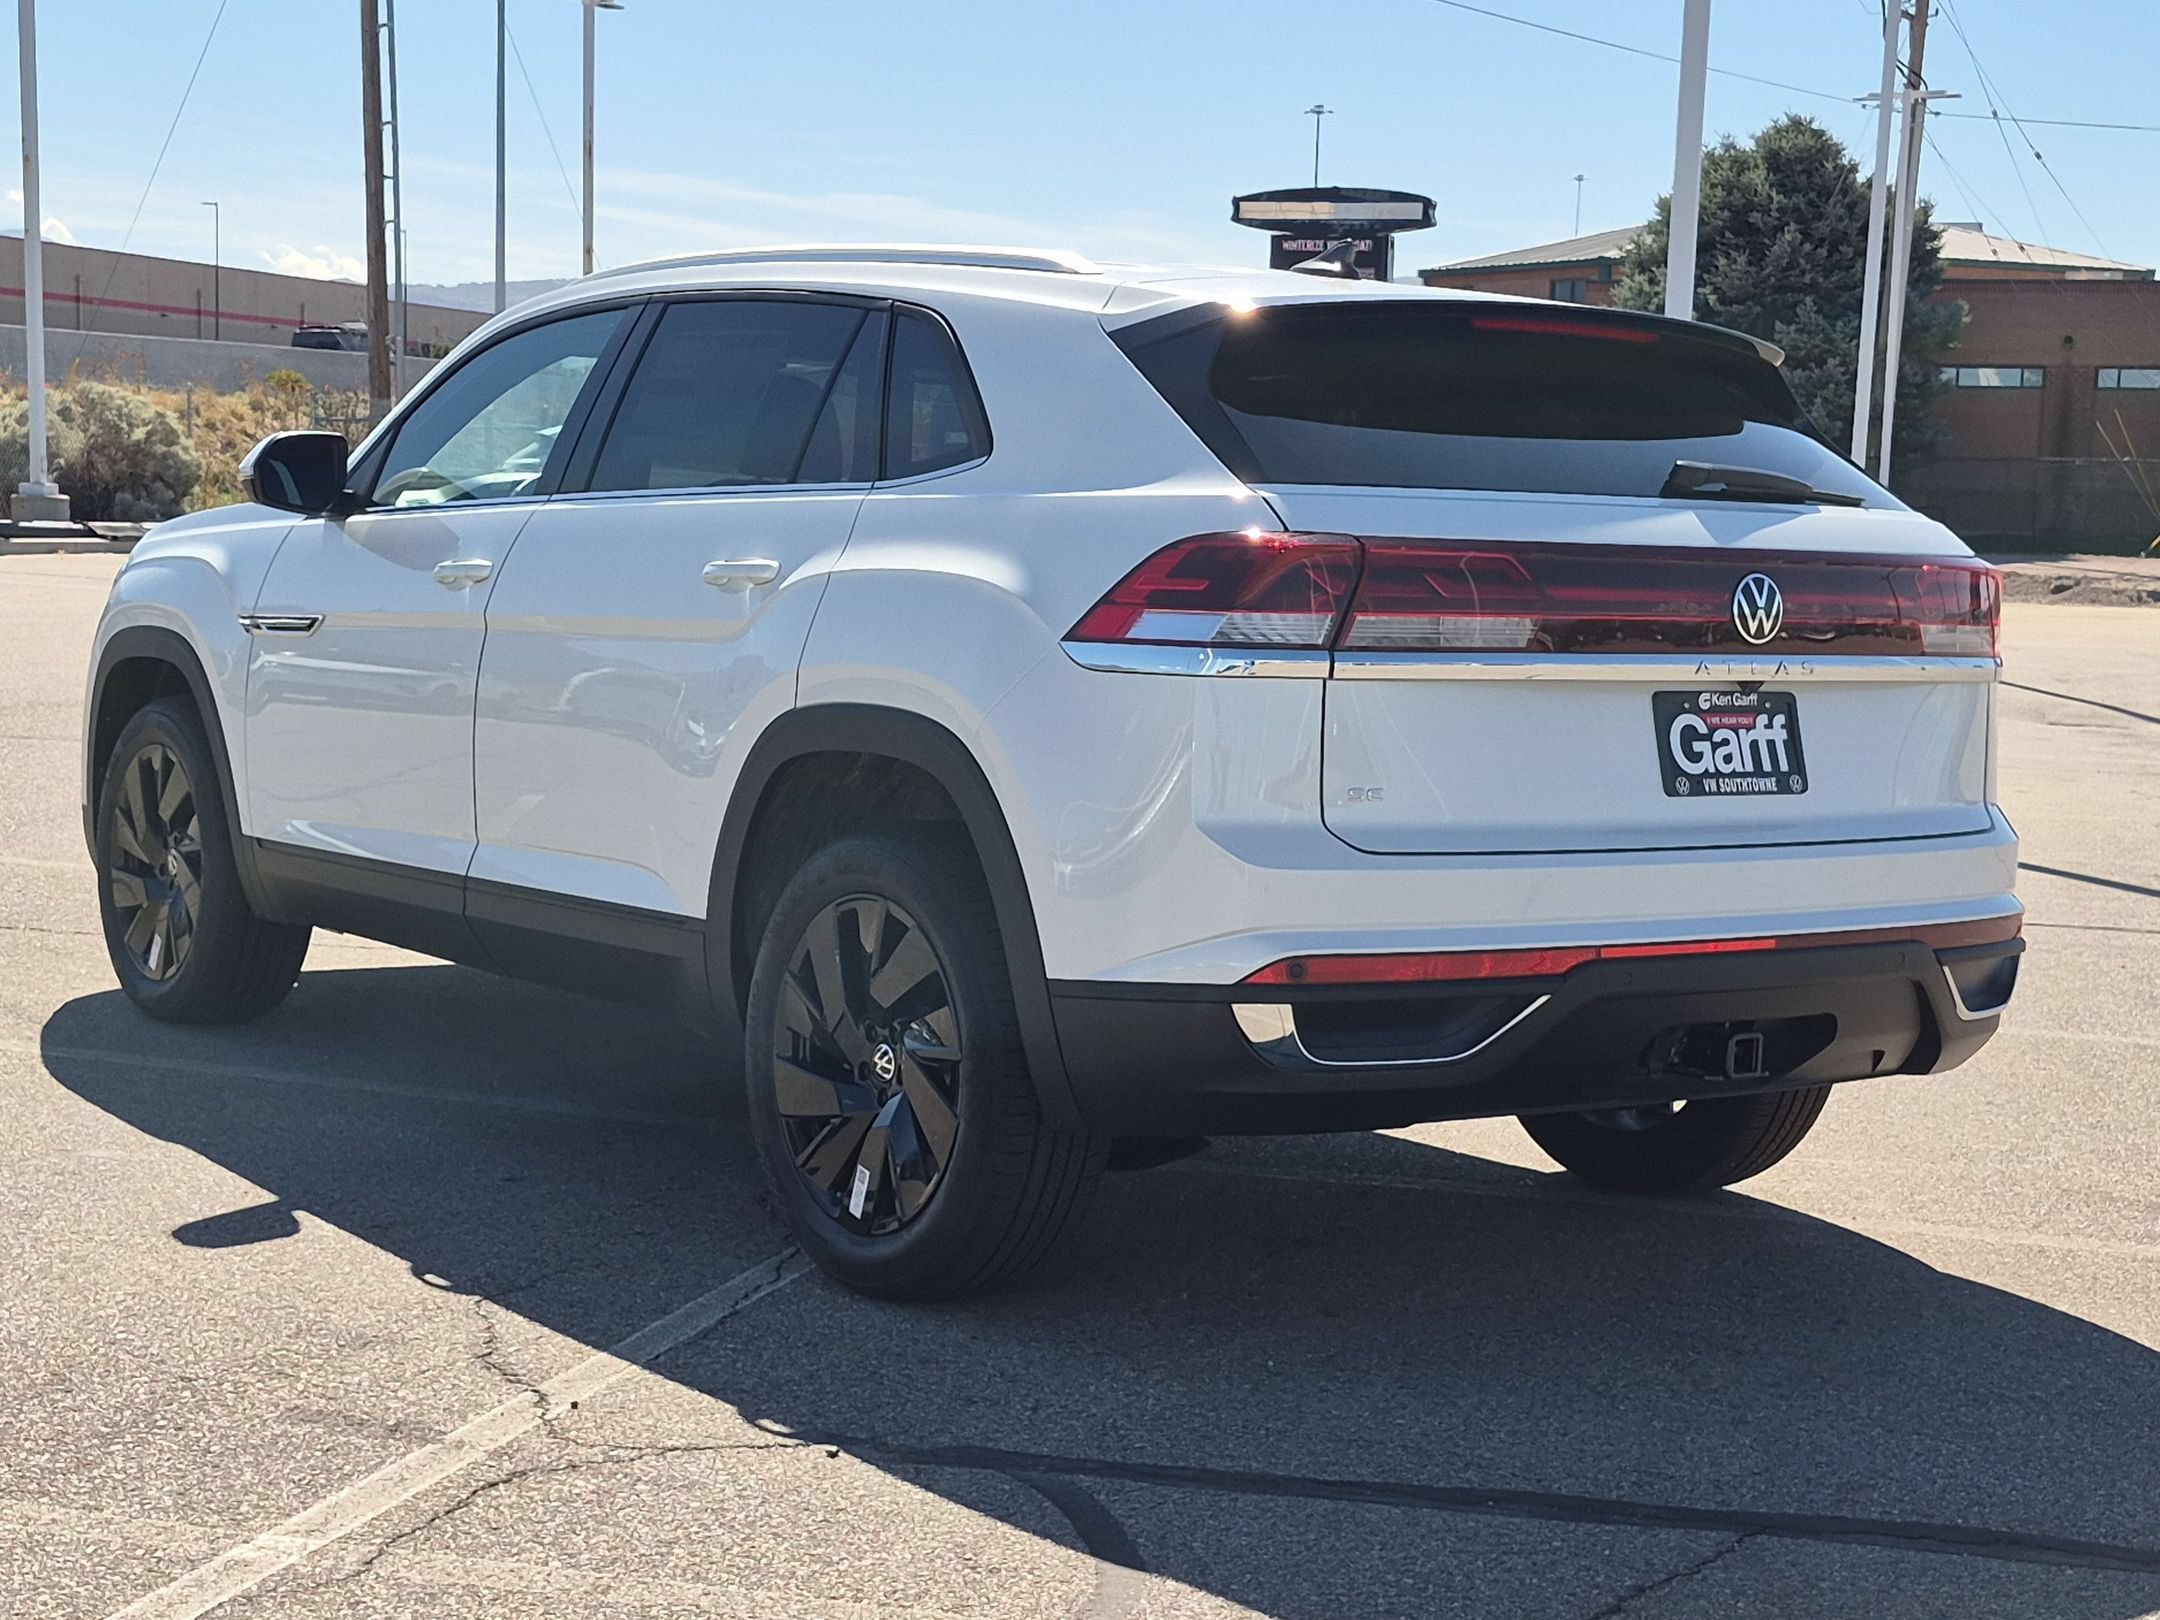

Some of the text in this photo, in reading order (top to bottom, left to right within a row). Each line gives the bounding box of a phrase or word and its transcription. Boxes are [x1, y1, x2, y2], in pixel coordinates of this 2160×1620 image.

[1733, 573, 1783, 645] VW
[1694, 659, 1816, 676] ATLAS
[1711, 692, 1732, 706] Ken
[1732, 692, 1758, 706] Garff
[1669, 713, 1789, 775] Garff
[1703, 777, 1778, 793] VW SOUTHTOWNE
